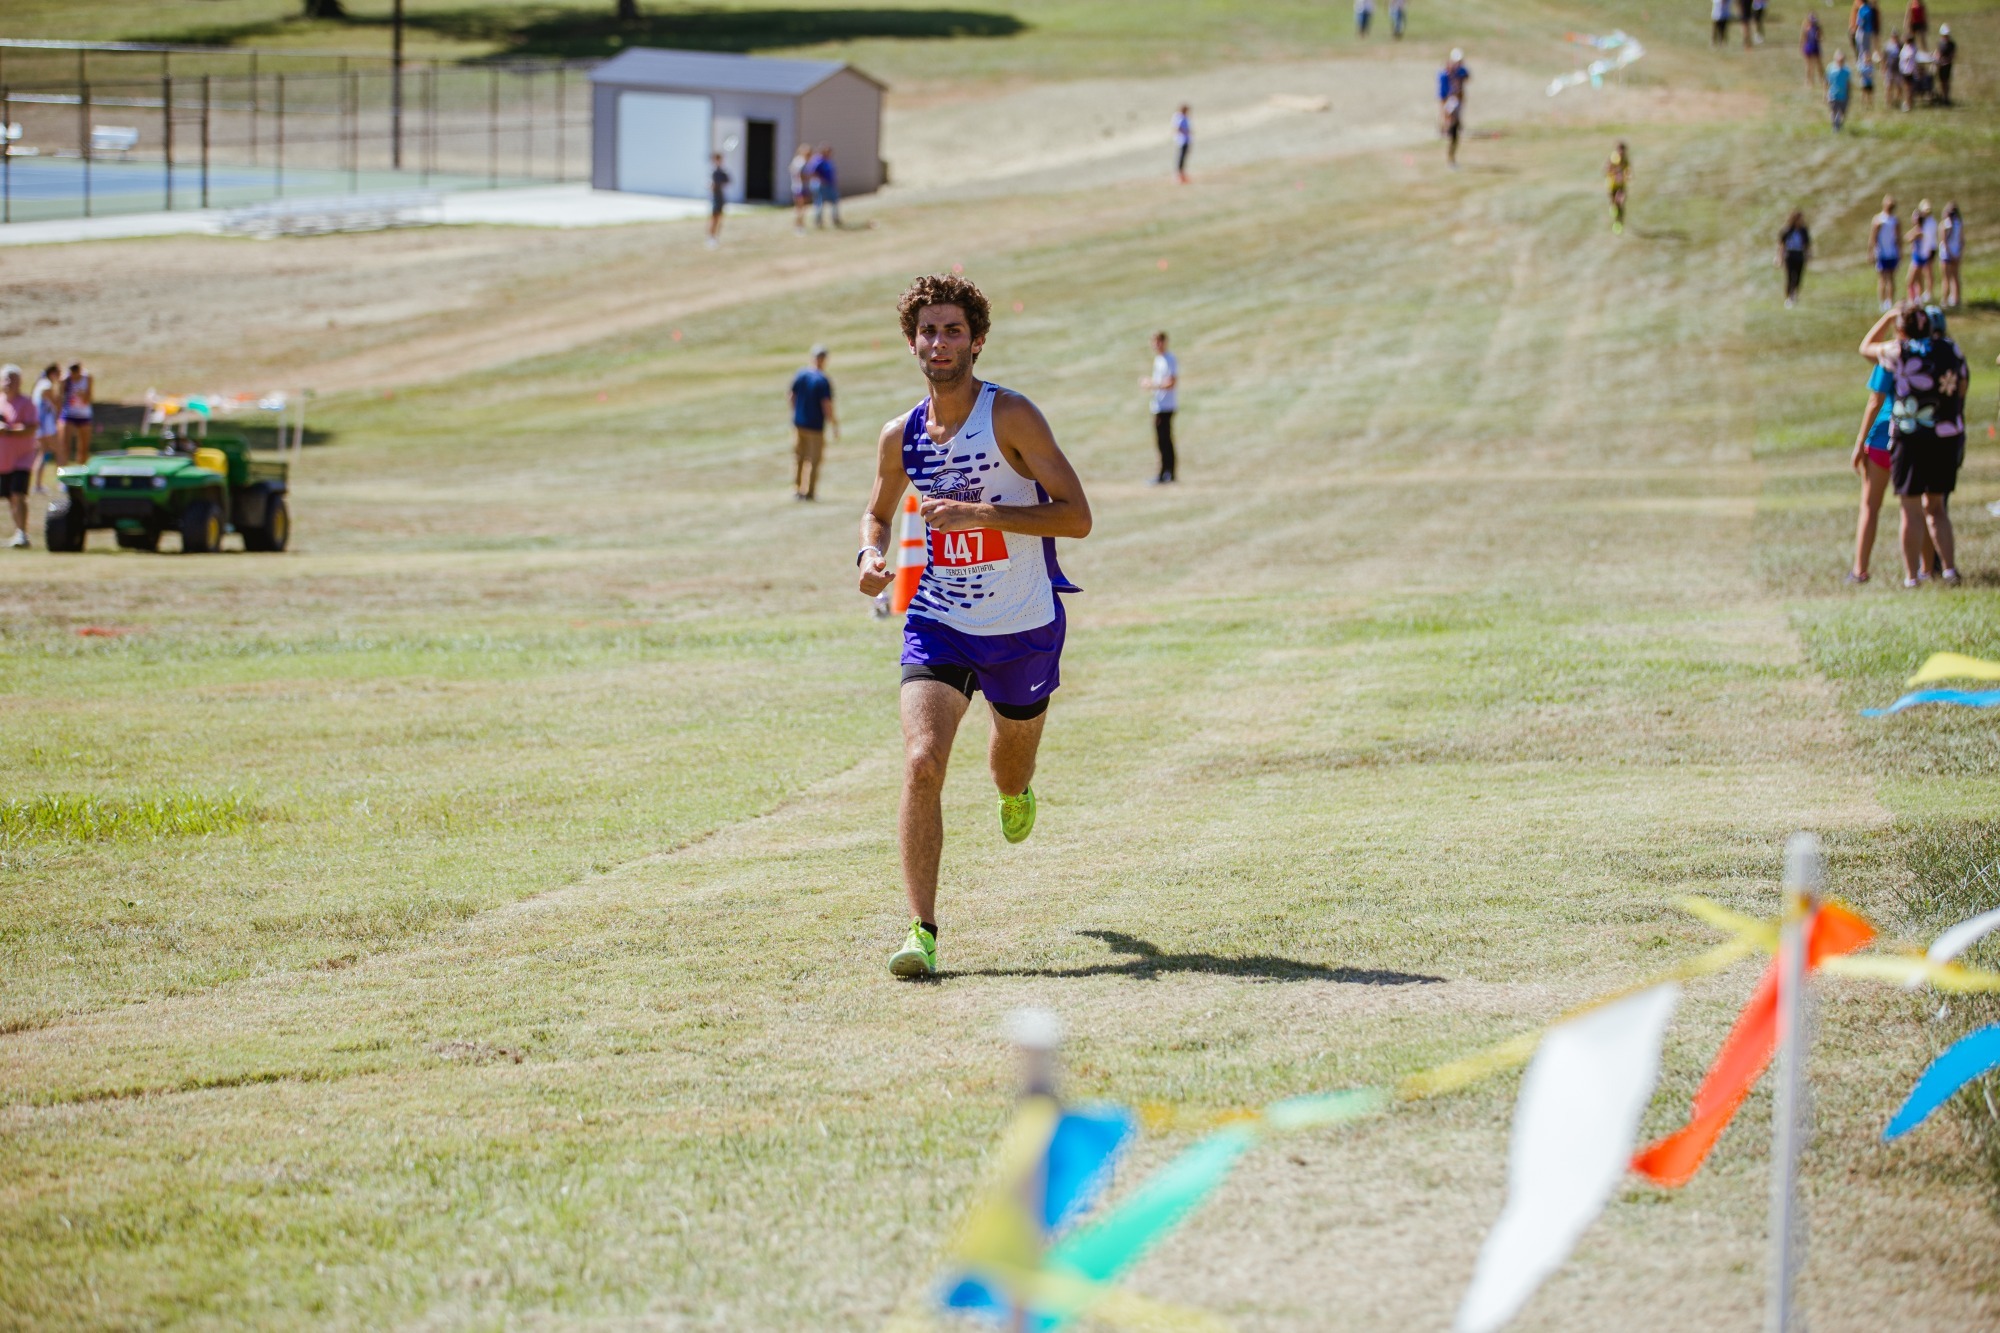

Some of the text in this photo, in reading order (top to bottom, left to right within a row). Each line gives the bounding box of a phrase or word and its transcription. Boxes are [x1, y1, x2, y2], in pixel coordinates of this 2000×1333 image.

[926, 490, 980, 502] BURY
[944, 531, 983, 564] 447
[968, 564, 995, 574] FAITHFUL
